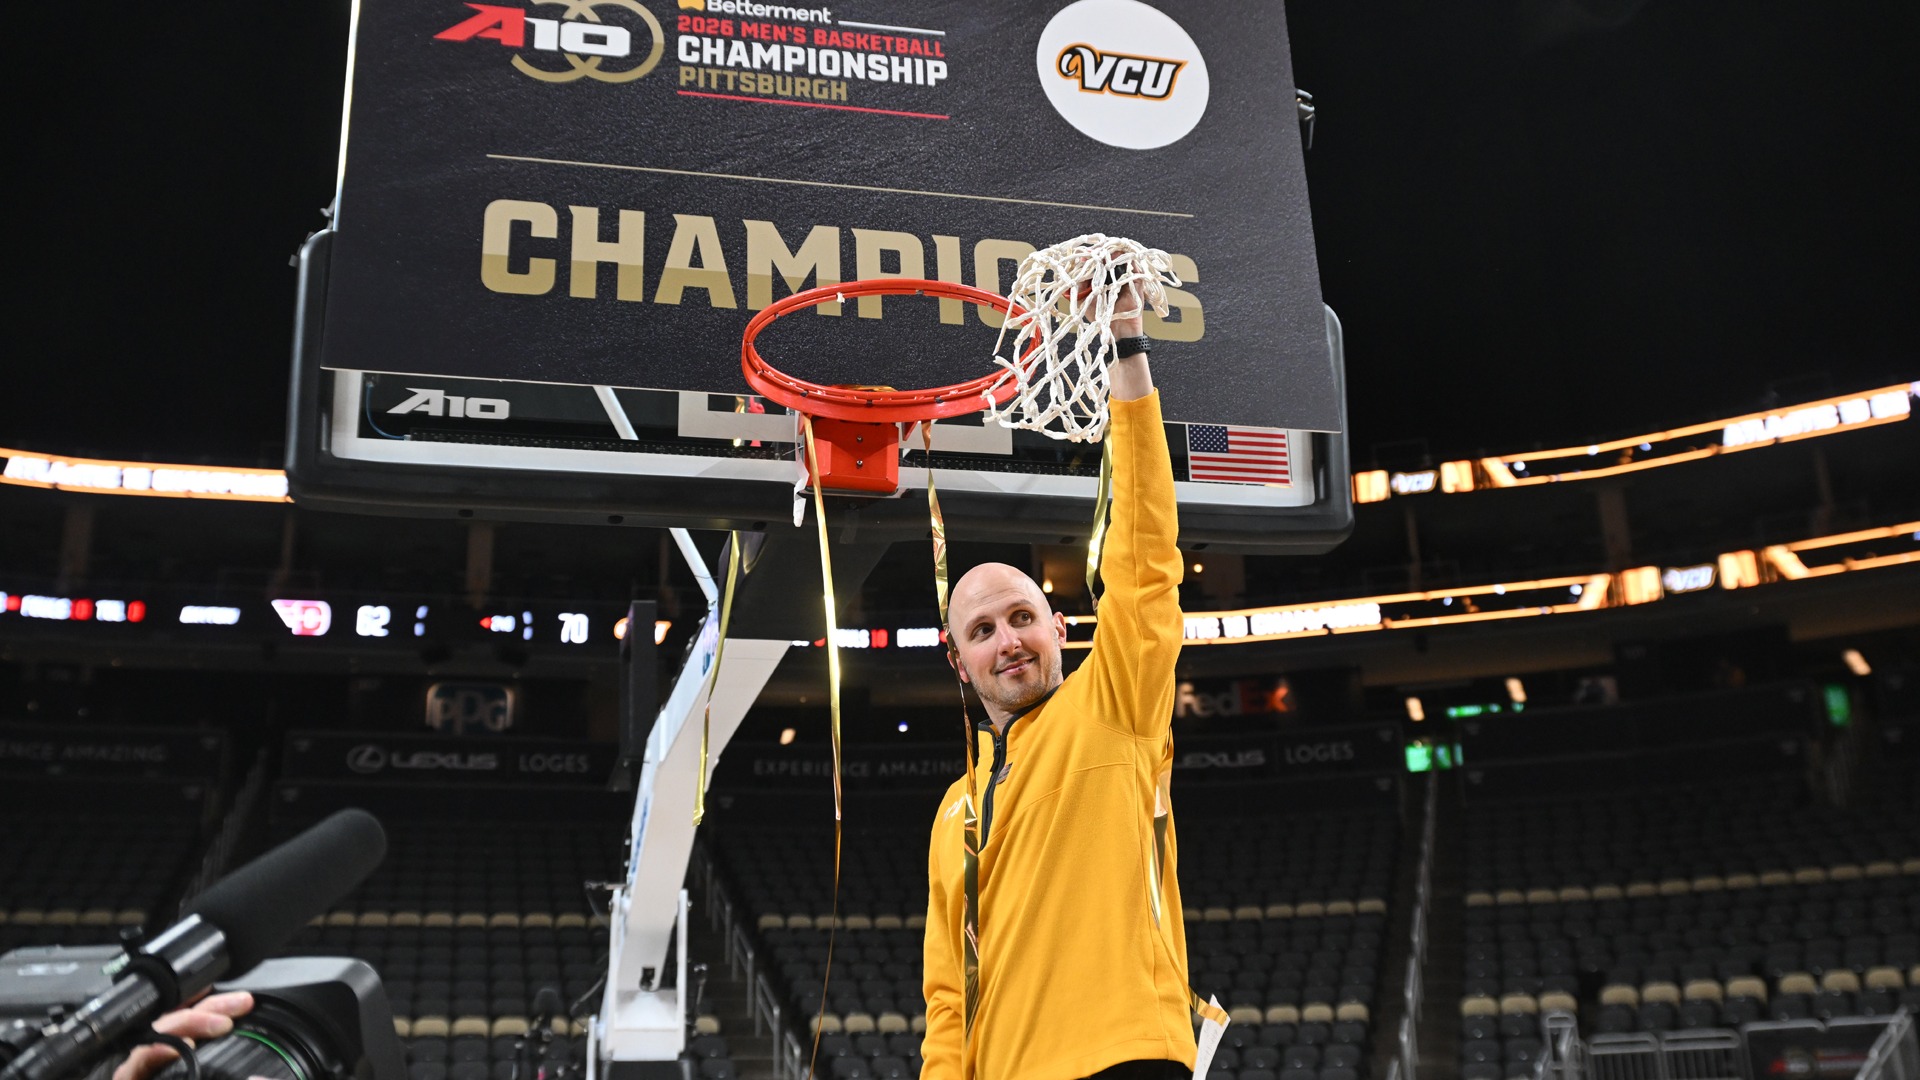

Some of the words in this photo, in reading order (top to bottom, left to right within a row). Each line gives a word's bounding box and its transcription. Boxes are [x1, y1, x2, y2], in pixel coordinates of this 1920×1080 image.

[433, 2, 631, 57] A10
[706, 0, 832, 25] Betterment
[677, 15, 734, 38] 2026
[741, 20, 807, 45] MEN'S
[814, 28, 946, 59] BASKETBALL
[677, 34, 949, 88] CHAMPIONSHIP
[1057, 43, 1187, 101] VCU
[679, 65, 848, 102] PITTSBURGH
[481, 199, 1206, 343] CHAMPIOS
[386, 387, 510, 421] A10
[558, 612, 589, 644] 70
[389, 751, 498, 770] LEXUS
[518, 753, 589, 773] LOGES
[1285, 741, 1354, 765] LOGES
